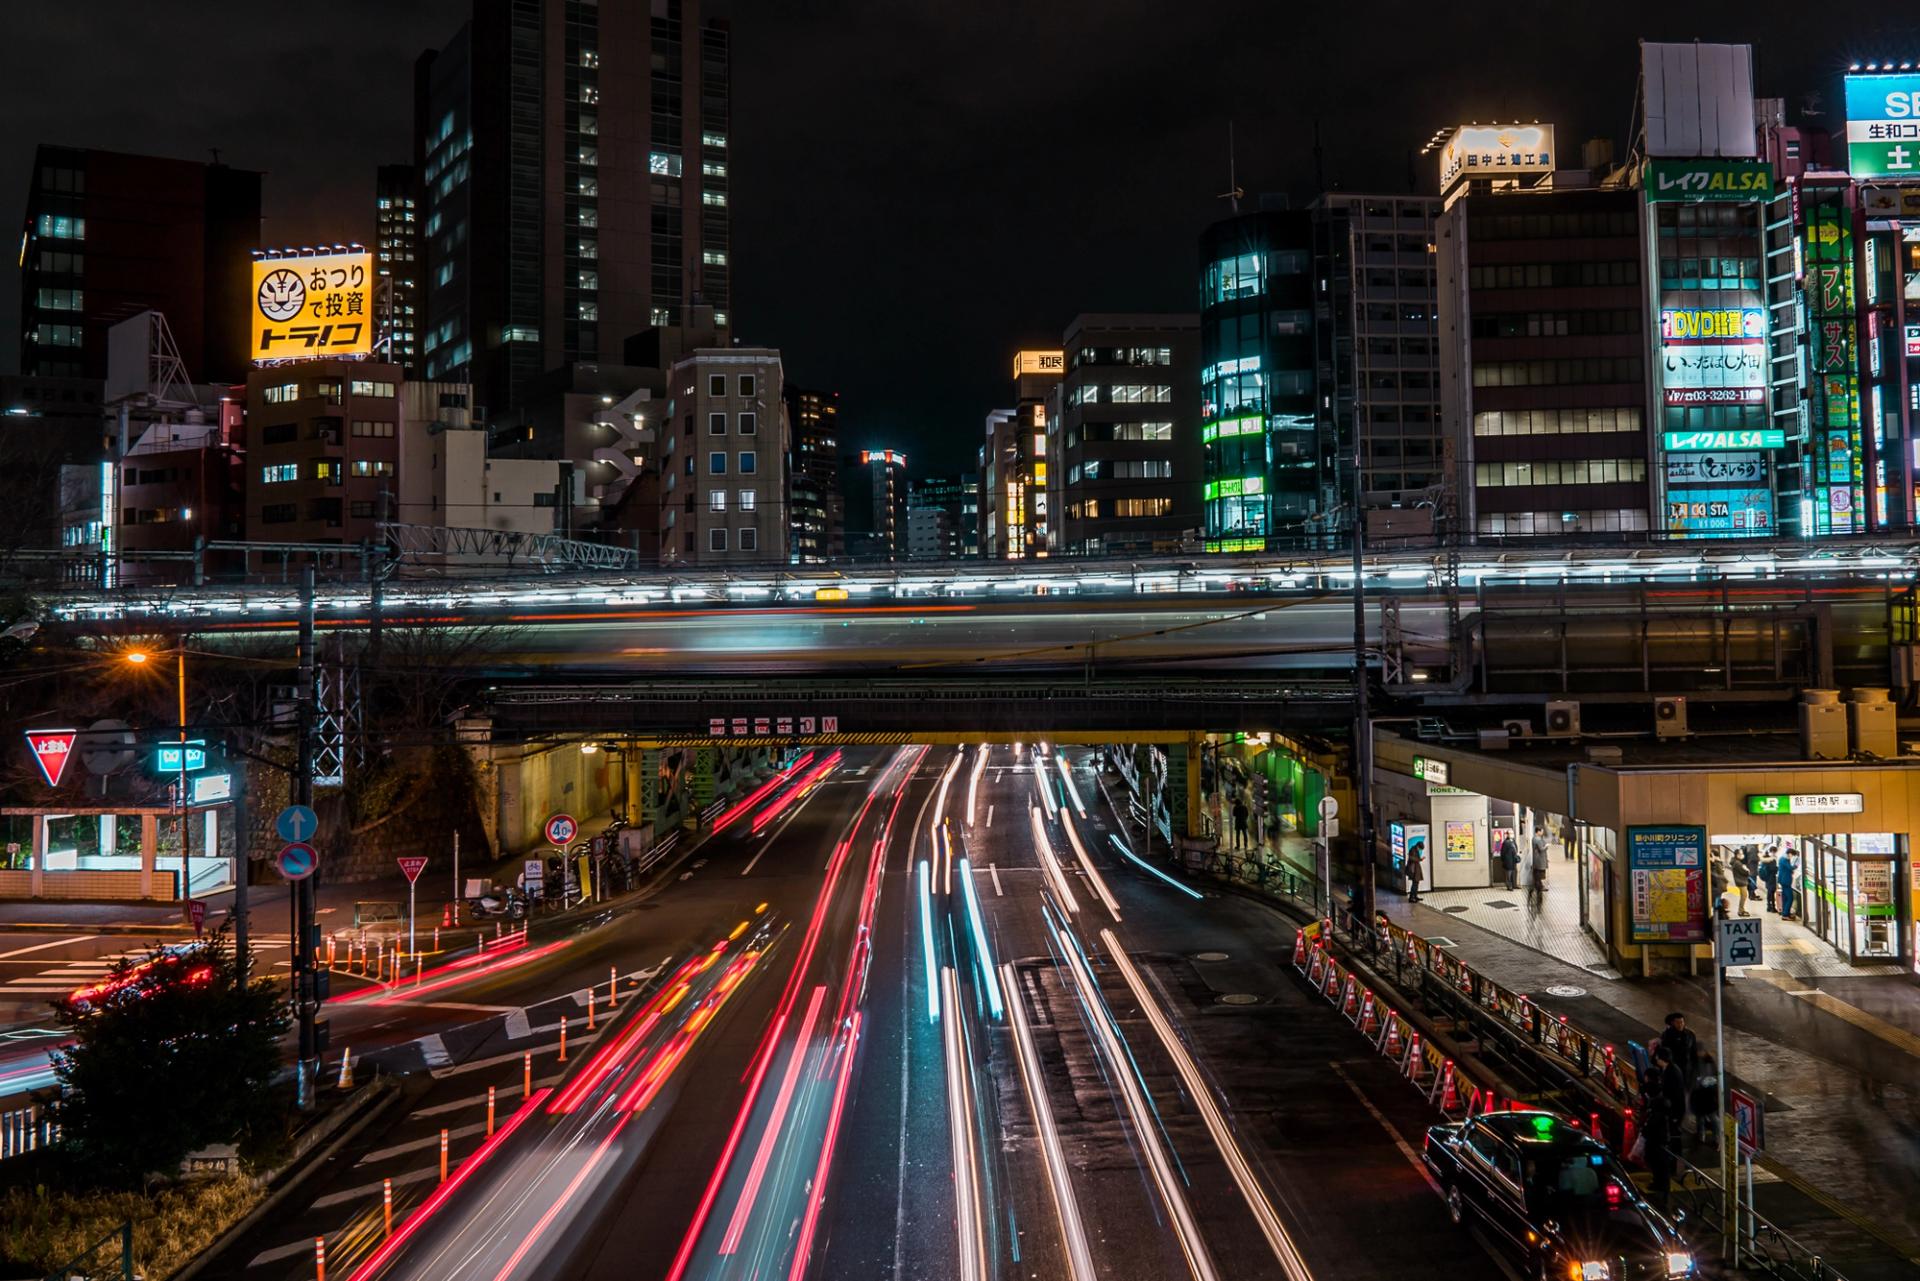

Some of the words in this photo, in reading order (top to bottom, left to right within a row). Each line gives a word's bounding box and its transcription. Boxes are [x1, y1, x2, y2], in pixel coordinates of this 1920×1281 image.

[1868, 124, 1920, 139] 生和コ
[1658, 172, 1768, 190] レイクALSA
[310, 265, 364, 291] おつり
[310, 292, 363, 318] で投資
[260, 323, 362, 350] トラノコ
[1040, 356, 1063, 368] 和民
[1694, 390, 1763, 401] 03-3262-11
[1672, 432, 1762, 449] レイクALSA
[38, 740, 68, 753] 止まれ
[1760, 798, 1779, 811] JR
[1795, 796, 1840, 806] 飯田橋駅
[1724, 923, 1759, 935] TAXI
